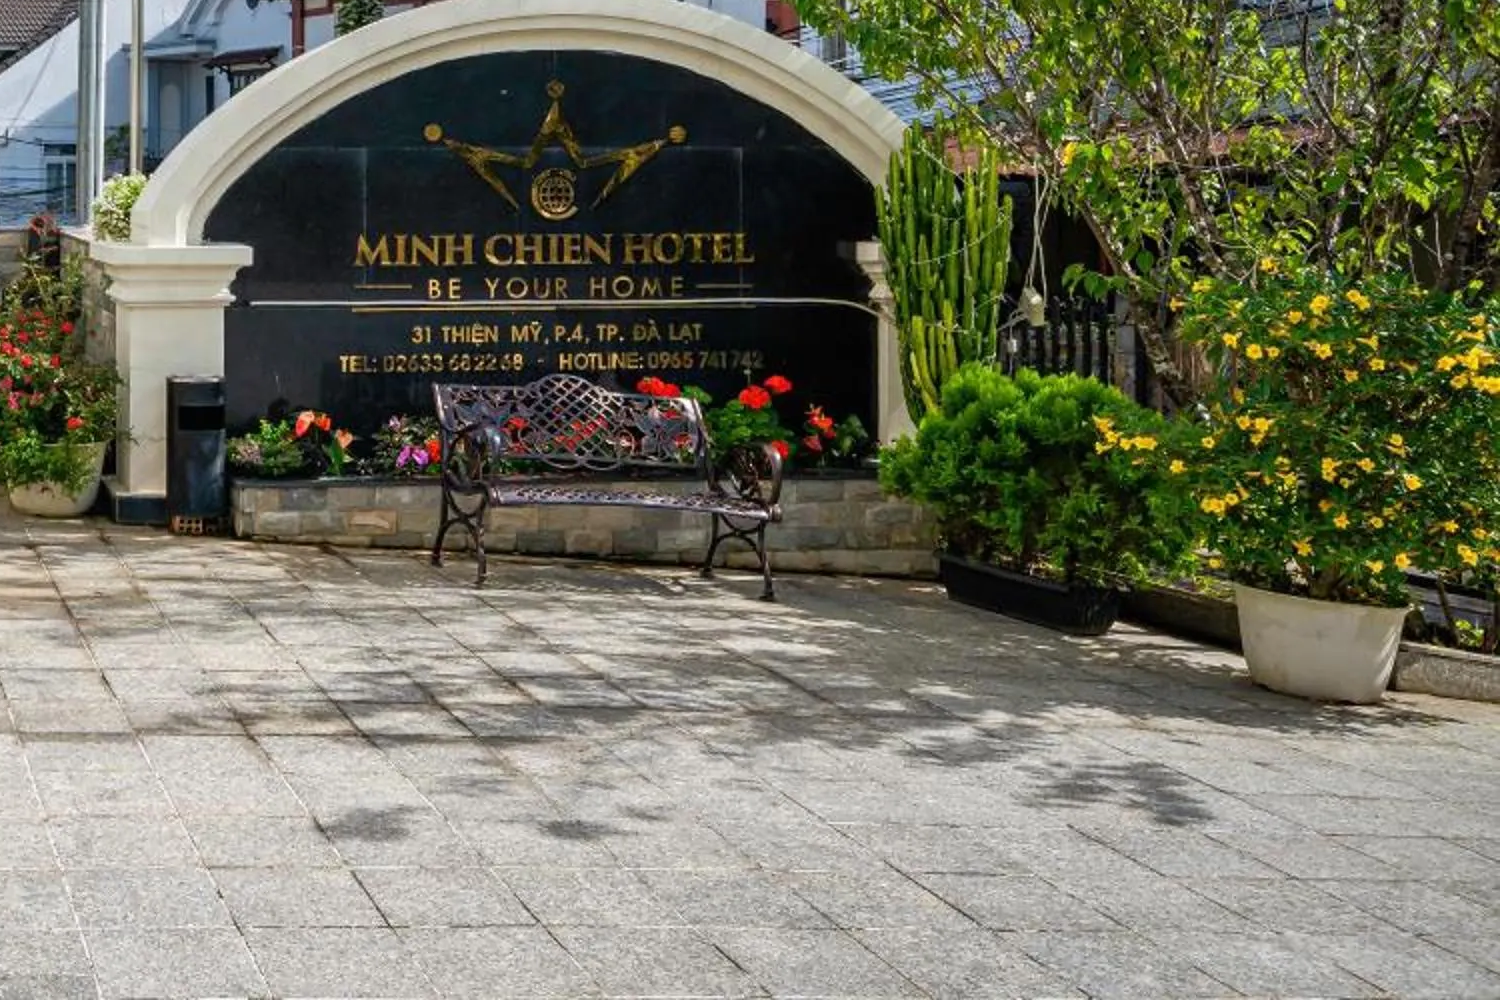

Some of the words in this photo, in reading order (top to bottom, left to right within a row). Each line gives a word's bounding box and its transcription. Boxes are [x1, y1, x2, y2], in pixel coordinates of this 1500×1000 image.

[353, 233, 476, 267] MINH
[484, 233, 613, 266] CHIEN
[622, 232, 755, 265] HOTEL
[427, 278, 461, 299] BE
[484, 277, 568, 298] YOUR
[589, 275, 685, 298] HOME
[411, 324, 431, 344] 31
[669, 322, 704, 344] LẠT
[339, 354, 377, 373] TEL:
[383, 353, 443, 372] 02633
[559, 351, 644, 371] HOTLINE:
